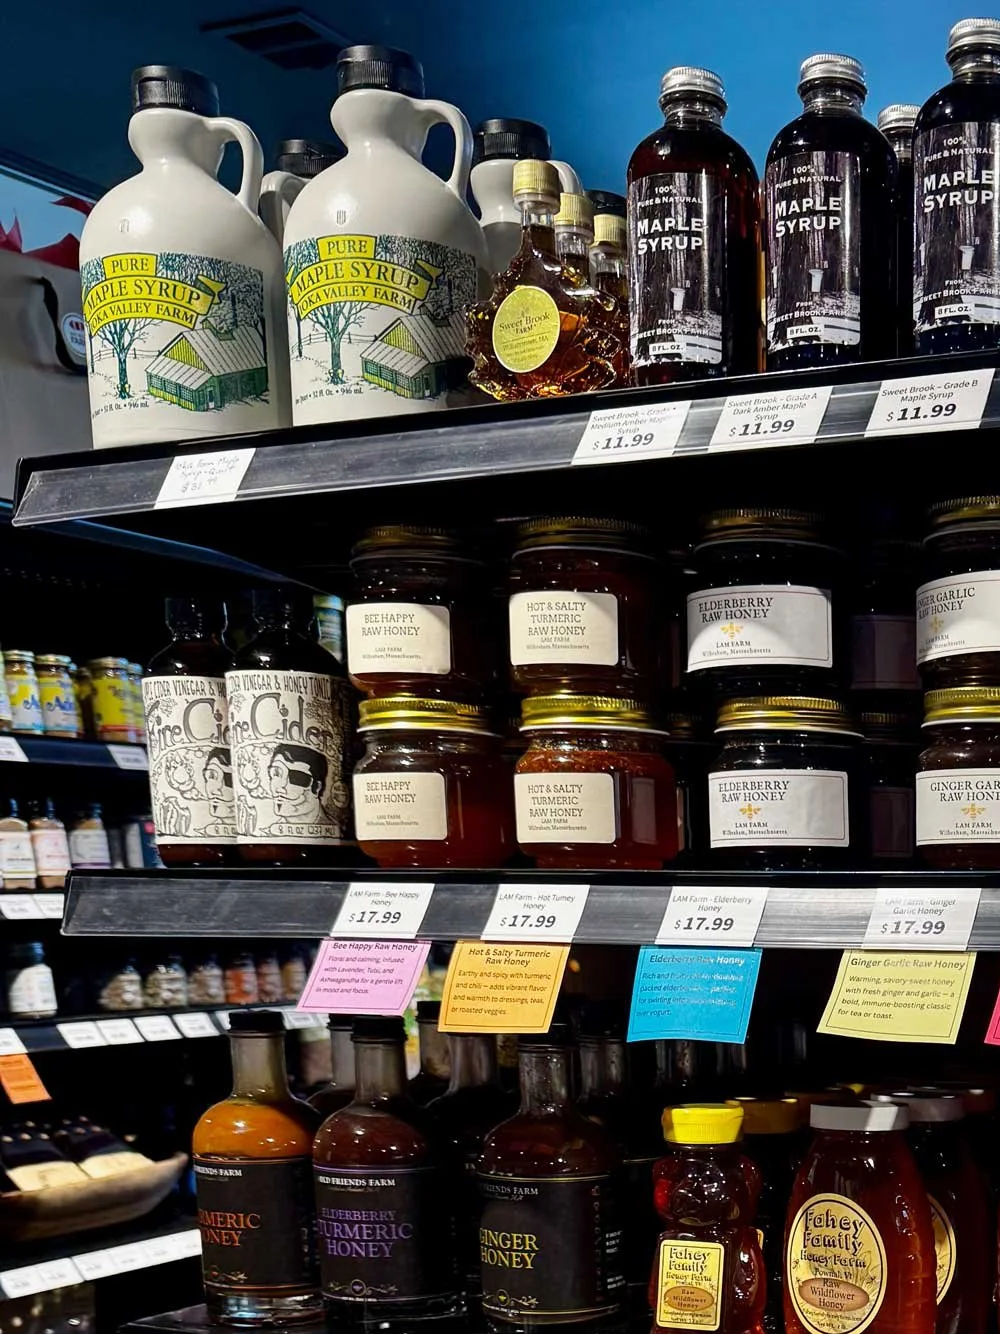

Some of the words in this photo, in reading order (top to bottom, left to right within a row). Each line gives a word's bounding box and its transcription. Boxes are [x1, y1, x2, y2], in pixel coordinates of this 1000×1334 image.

[924, 170, 994, 194] MAPLE
[775, 197, 841, 219] MAPLE
[924, 190, 994, 214] SYRUP
[637, 217, 703, 238] MAPLE
[775, 216, 841, 238] SYRUP
[328, 239, 367, 254] PURE
[637, 236, 703, 255] SYRUP
[112, 259, 149, 273] PURE
[297, 262, 345, 296] MAPLE
[351, 262, 418, 291] SYRUP
[88, 280, 128, 311] MAPLE
[134, 279, 200, 305] SYRUP
[324, 287, 368, 299] VALLEY
[374, 288, 412, 311] FARM
[527, 601, 546, 612] HOT
[554, 601, 586, 612] SALTY
[364, 614, 380, 624] BEE
[380, 613, 415, 624] HAPPY
[530, 614, 581, 624] TURMERIC
[251, 691, 334, 750] Cider
[718, 780, 790, 792] ELDERBERRY
[929, 780, 970, 792] GINGER
[327, 1241, 395, 1259] HONEY
[479, 1248, 537, 1269] HONEY
